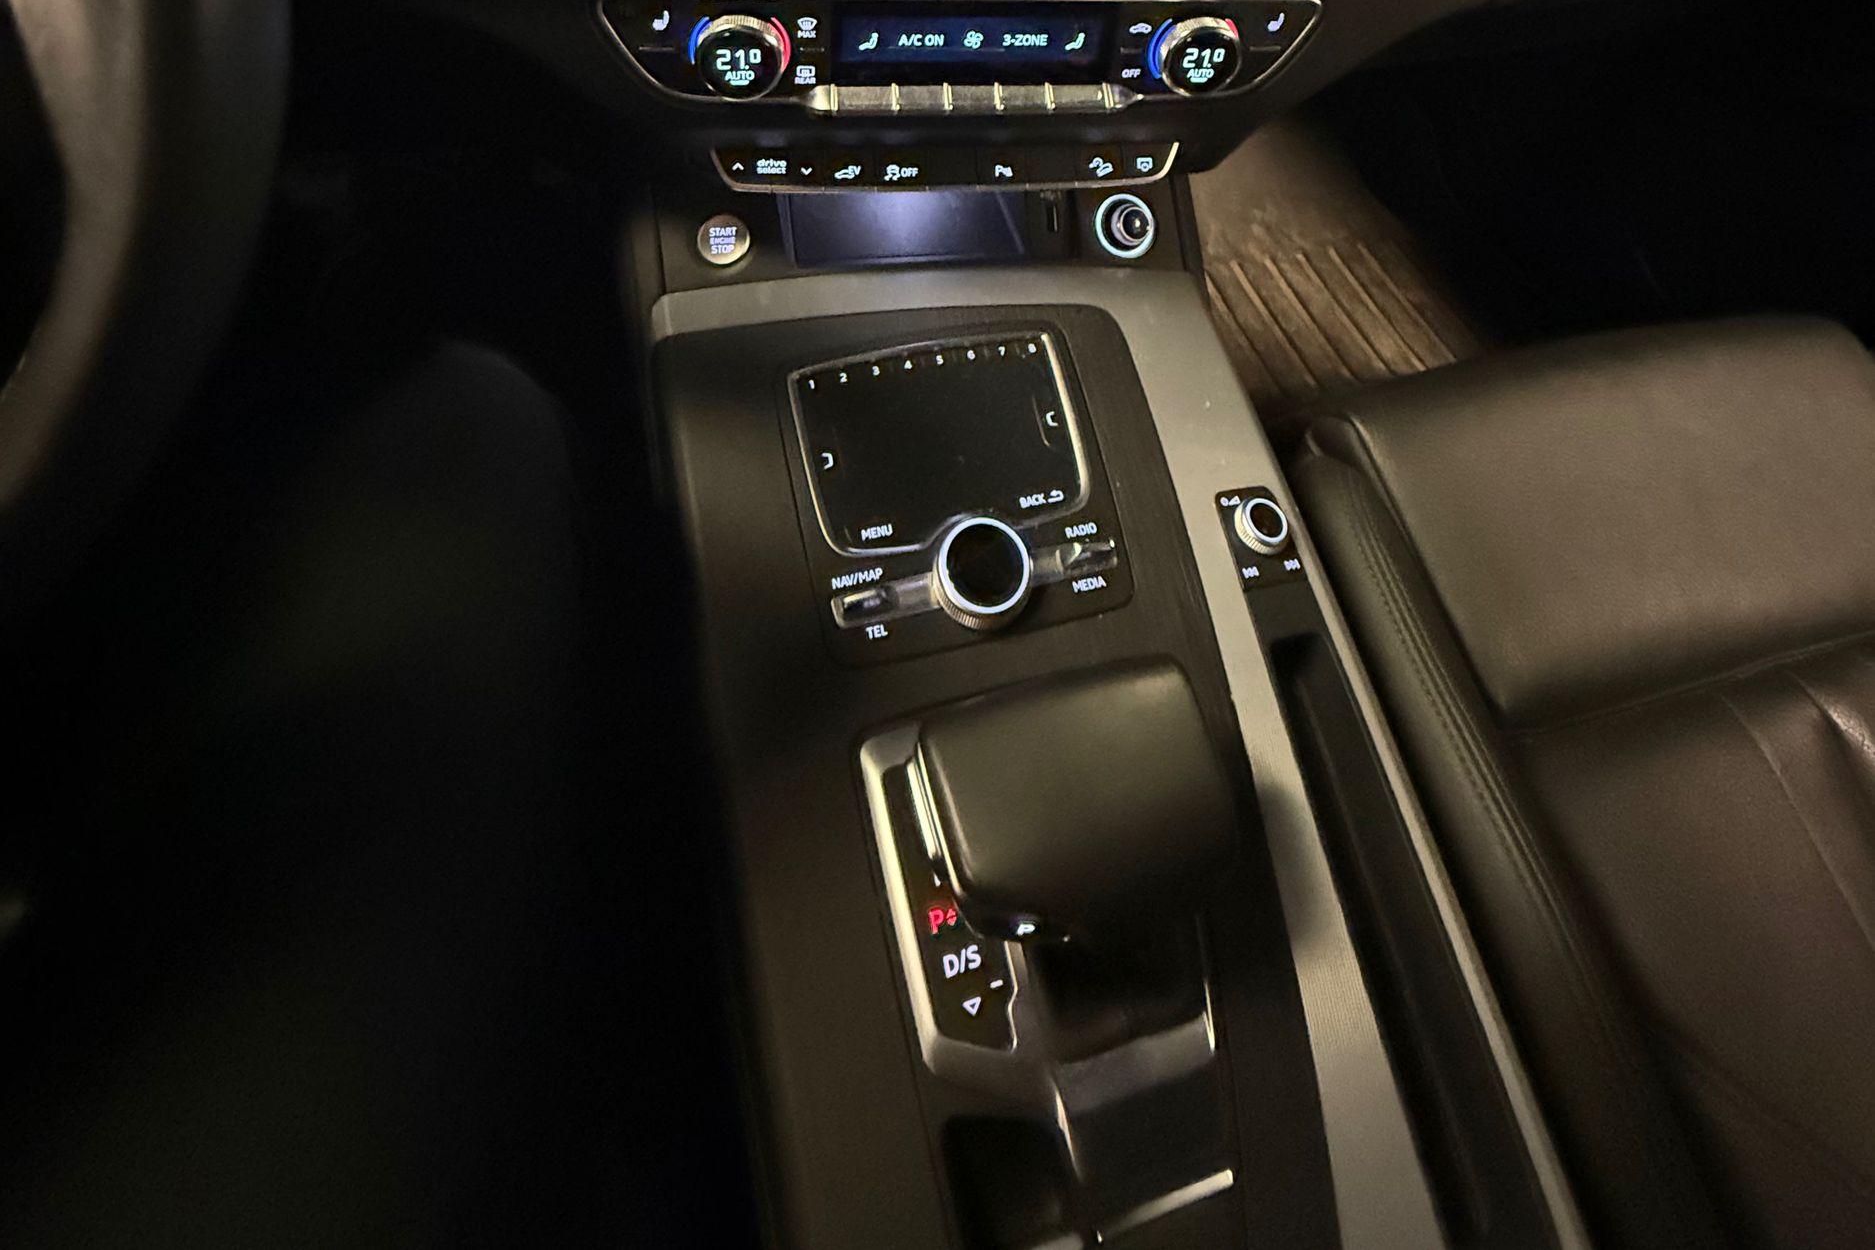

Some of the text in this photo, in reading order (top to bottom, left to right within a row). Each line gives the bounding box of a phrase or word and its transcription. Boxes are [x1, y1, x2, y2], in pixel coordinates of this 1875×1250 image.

[797, 31, 816, 39] MAX
[898, 34, 945, 47] A/C ON
[1003, 34, 1049, 47] 3-ZONE
[725, 70, 755, 81] AUTO
[1121, 68, 1141, 78] OFF
[1187, 68, 1215, 79] AUTO
[794, 76, 816, 85] REAR
[756, 158, 787, 167] drive
[756, 166, 787, 175] select
[848, 165, 862, 176] EV
[900, 167, 918, 178] OFF
[709, 227, 737, 237] START
[710, 236, 736, 245] ENGINE
[711, 244, 735, 254] STOP
[808, 343, 1037, 390] 1 2 3 4 5 6 7 8
[1019, 493, 1046, 509] BACK
[860, 523, 893, 541] MENU
[1065, 522, 1097, 538] RADIO
[831, 567, 883, 590] NAV/MAP
[1072, 576, 1107, 593] MEDIA
[866, 624, 888, 640] TEL
[942, 944, 982, 979] D/S
